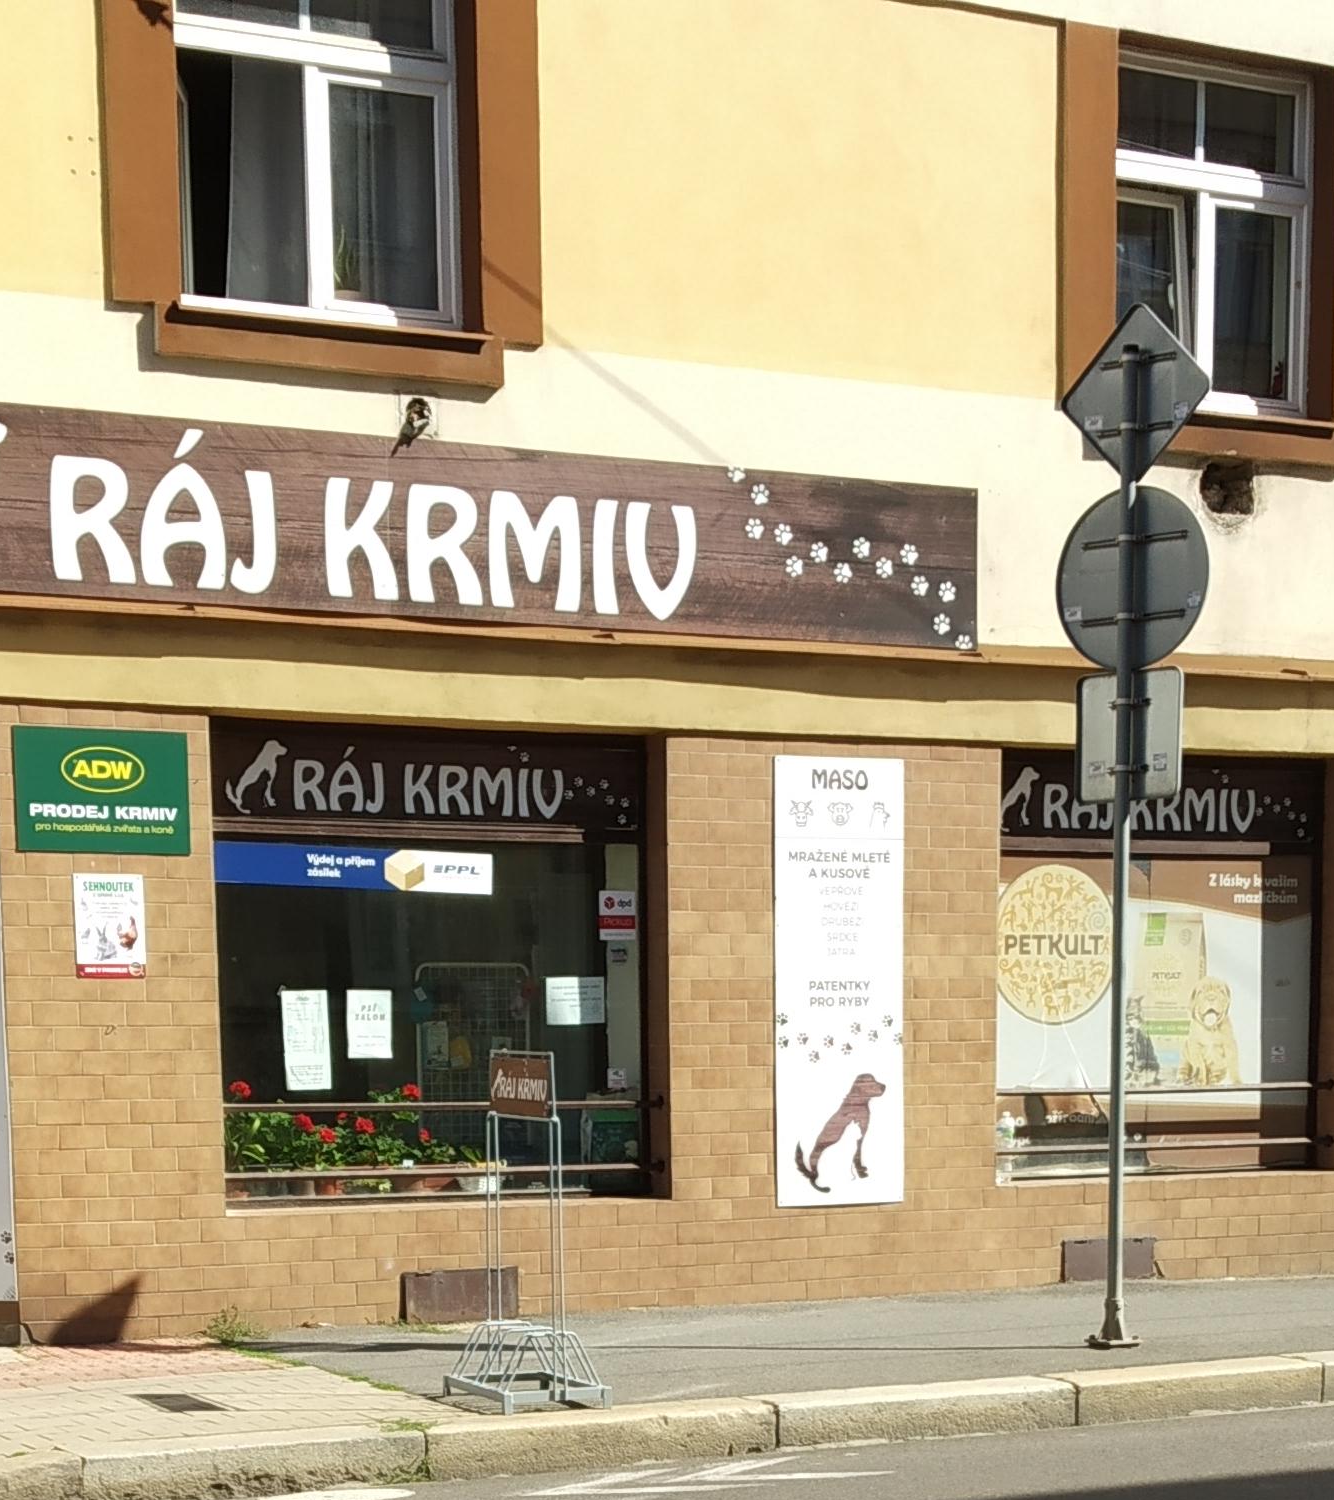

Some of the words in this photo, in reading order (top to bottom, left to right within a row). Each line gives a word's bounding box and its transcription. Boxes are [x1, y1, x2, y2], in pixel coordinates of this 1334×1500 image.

[50, 427, 273, 597] RÁJ
[323, 475, 699, 621] KRMIV
[72, 759, 134, 780] ADW
[292, 745, 386, 814] RÁJ
[403, 763, 565, 820] KRMIV
[811, 768, 869, 791] MASO
[29, 803, 110, 819] PRODEJ
[115, 806, 178, 822] KRMIV
[34, 824, 52, 833] pro
[306, 853, 335, 867] Výdej
[336, 857, 343, 866] a
[344, 855, 376, 869] příjem
[788, 848, 848, 863] MRAŽENÉ
[851, 850, 891, 863] MLETÉ
[306, 867, 342, 879] zásilek
[444, 865, 481, 876] PPL
[808, 867, 817, 879] A
[820, 865, 871, 879] KUSOVÉ
[82, 881, 134, 892] SEHNOUTEK
[1208, 874, 1218, 887] Z
[1219, 873, 1251, 890] lásky
[1253, 873, 1262, 888] k
[616, 898, 632, 909] dpd
[1003, 932, 1105, 960] PETKULT
[808, 980, 871, 992] PATENTKY
[809, 997, 835, 1007] PRO
[838, 997, 870, 1007] RYBY
[498, 1072, 516, 1099] RÁJ
[517, 1076, 548, 1101] KRMIV
